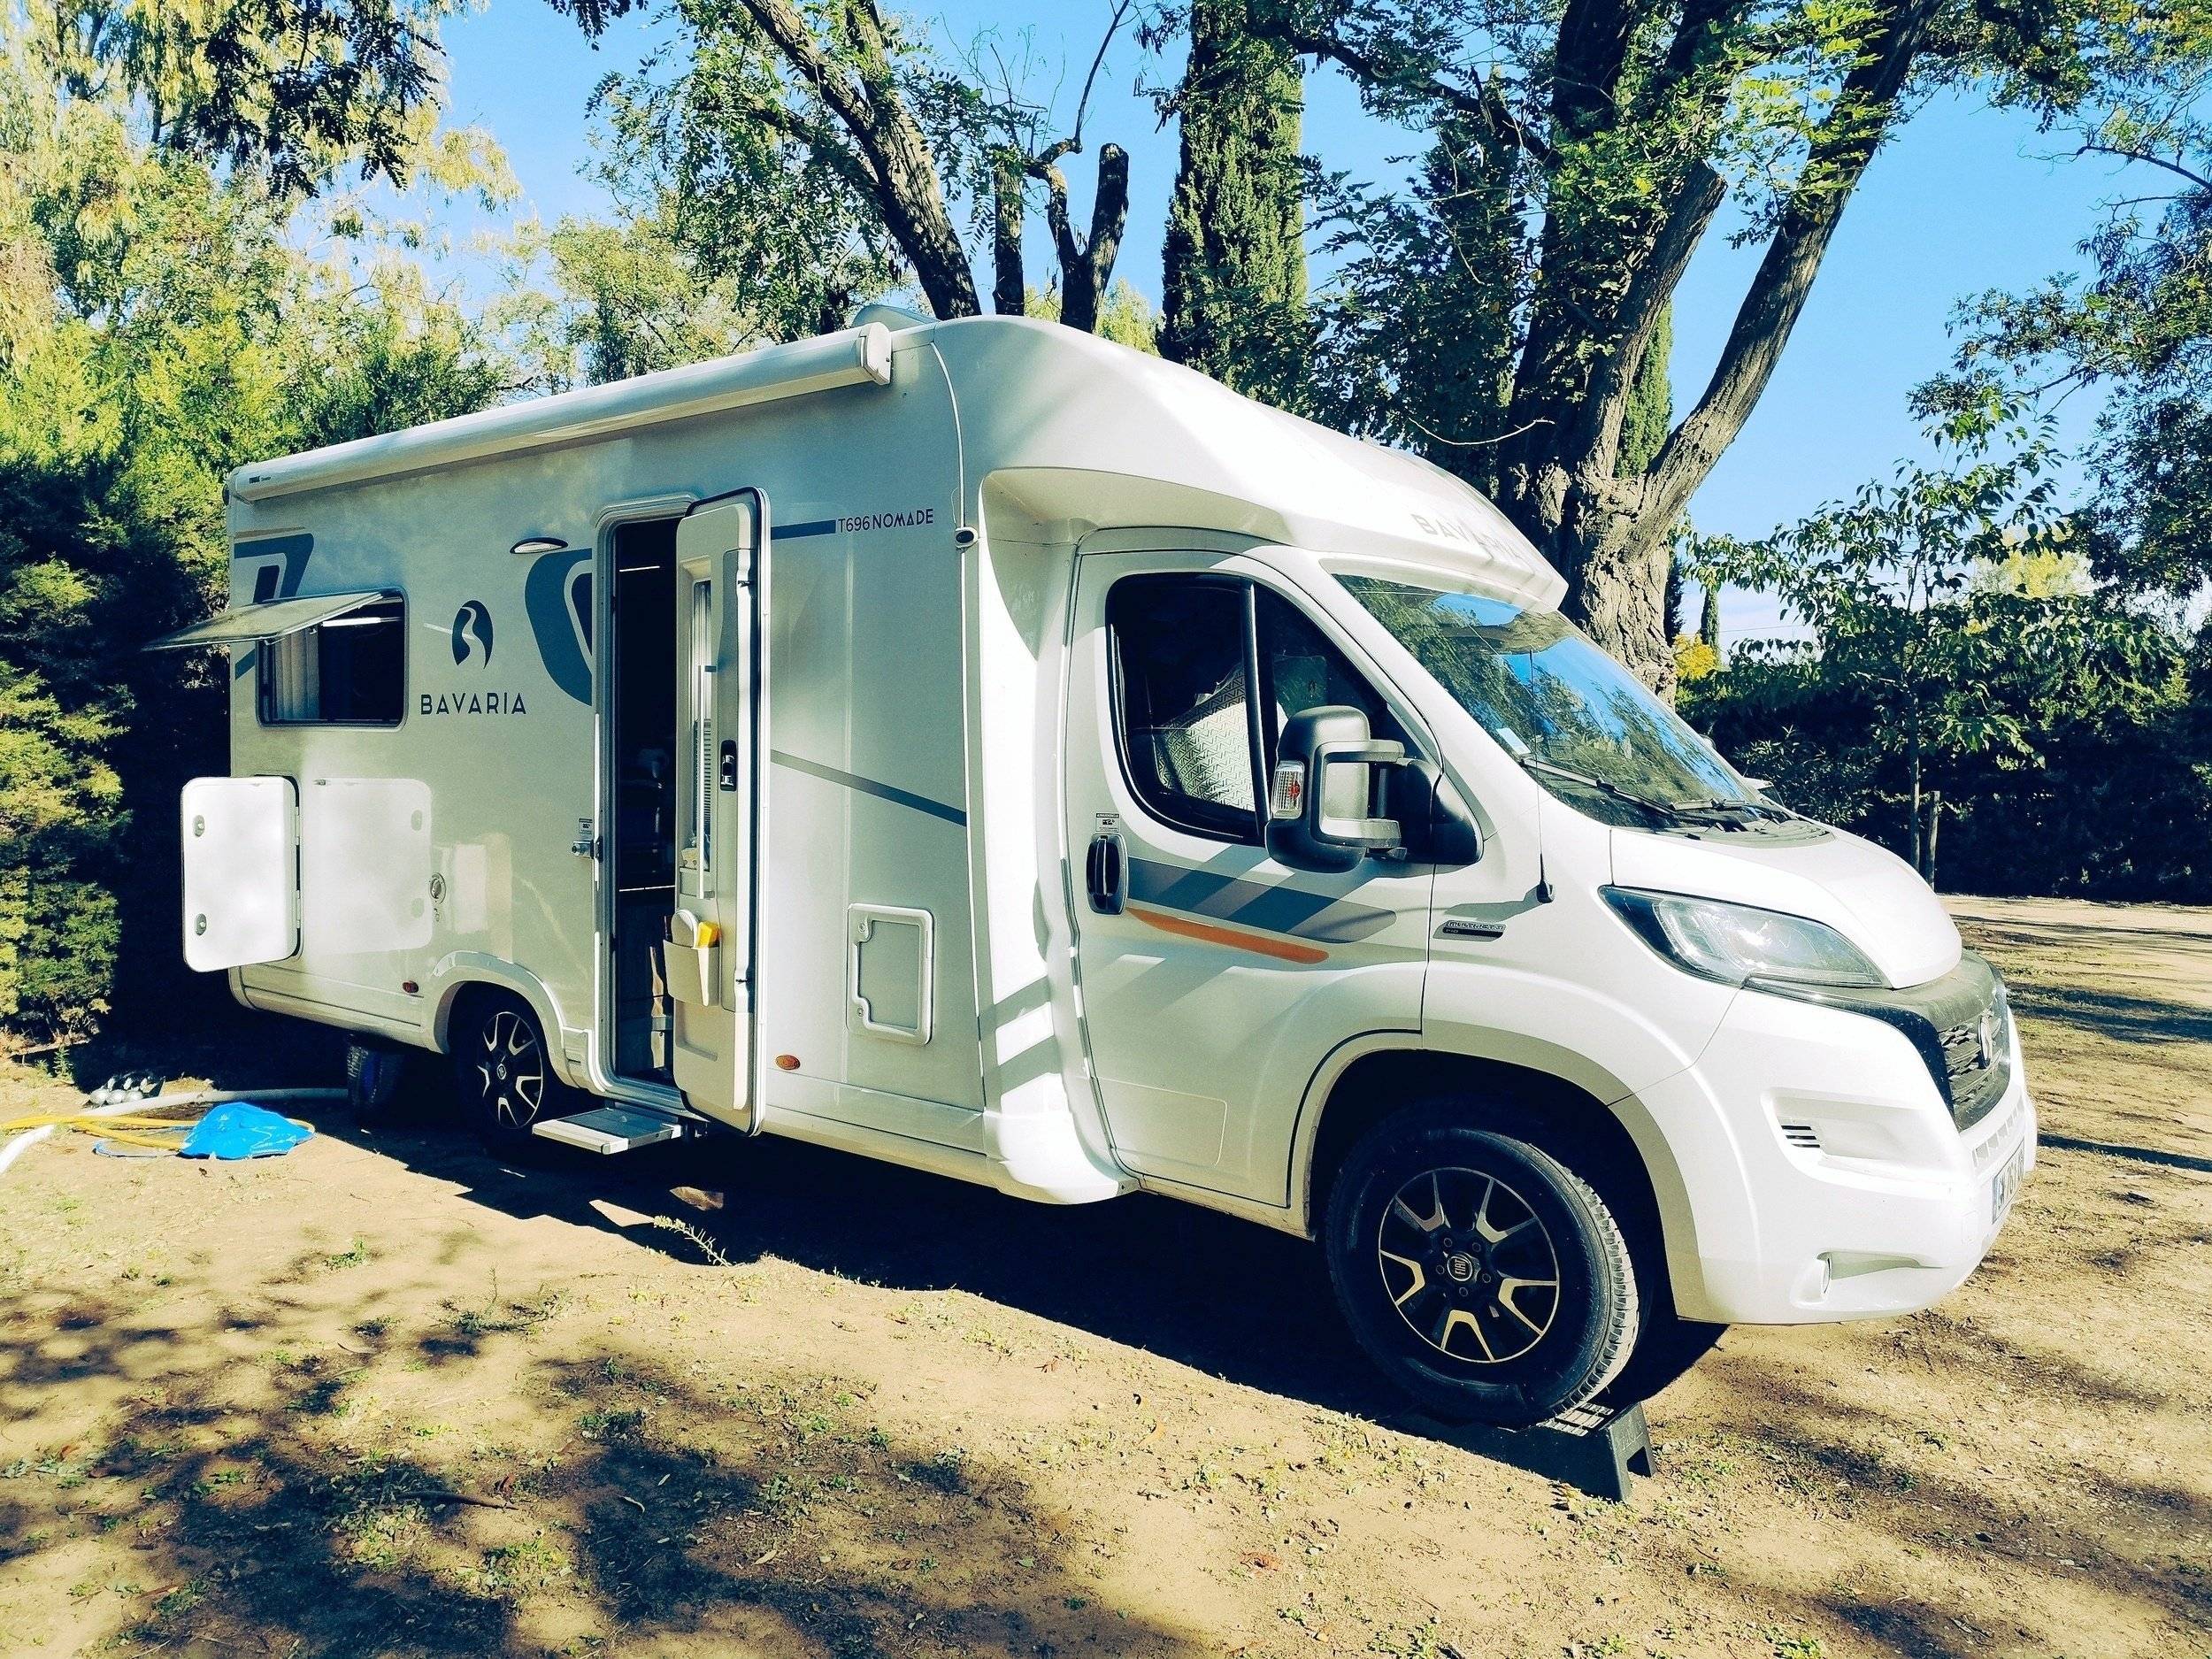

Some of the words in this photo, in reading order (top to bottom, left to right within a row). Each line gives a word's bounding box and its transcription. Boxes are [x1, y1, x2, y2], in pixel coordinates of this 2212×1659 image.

[838, 515, 870, 533] T696
[872, 508, 933, 529] NOMADE
[420, 692, 526, 715] BAVARIA
[1454, 1258, 1466, 1275] FIAT
